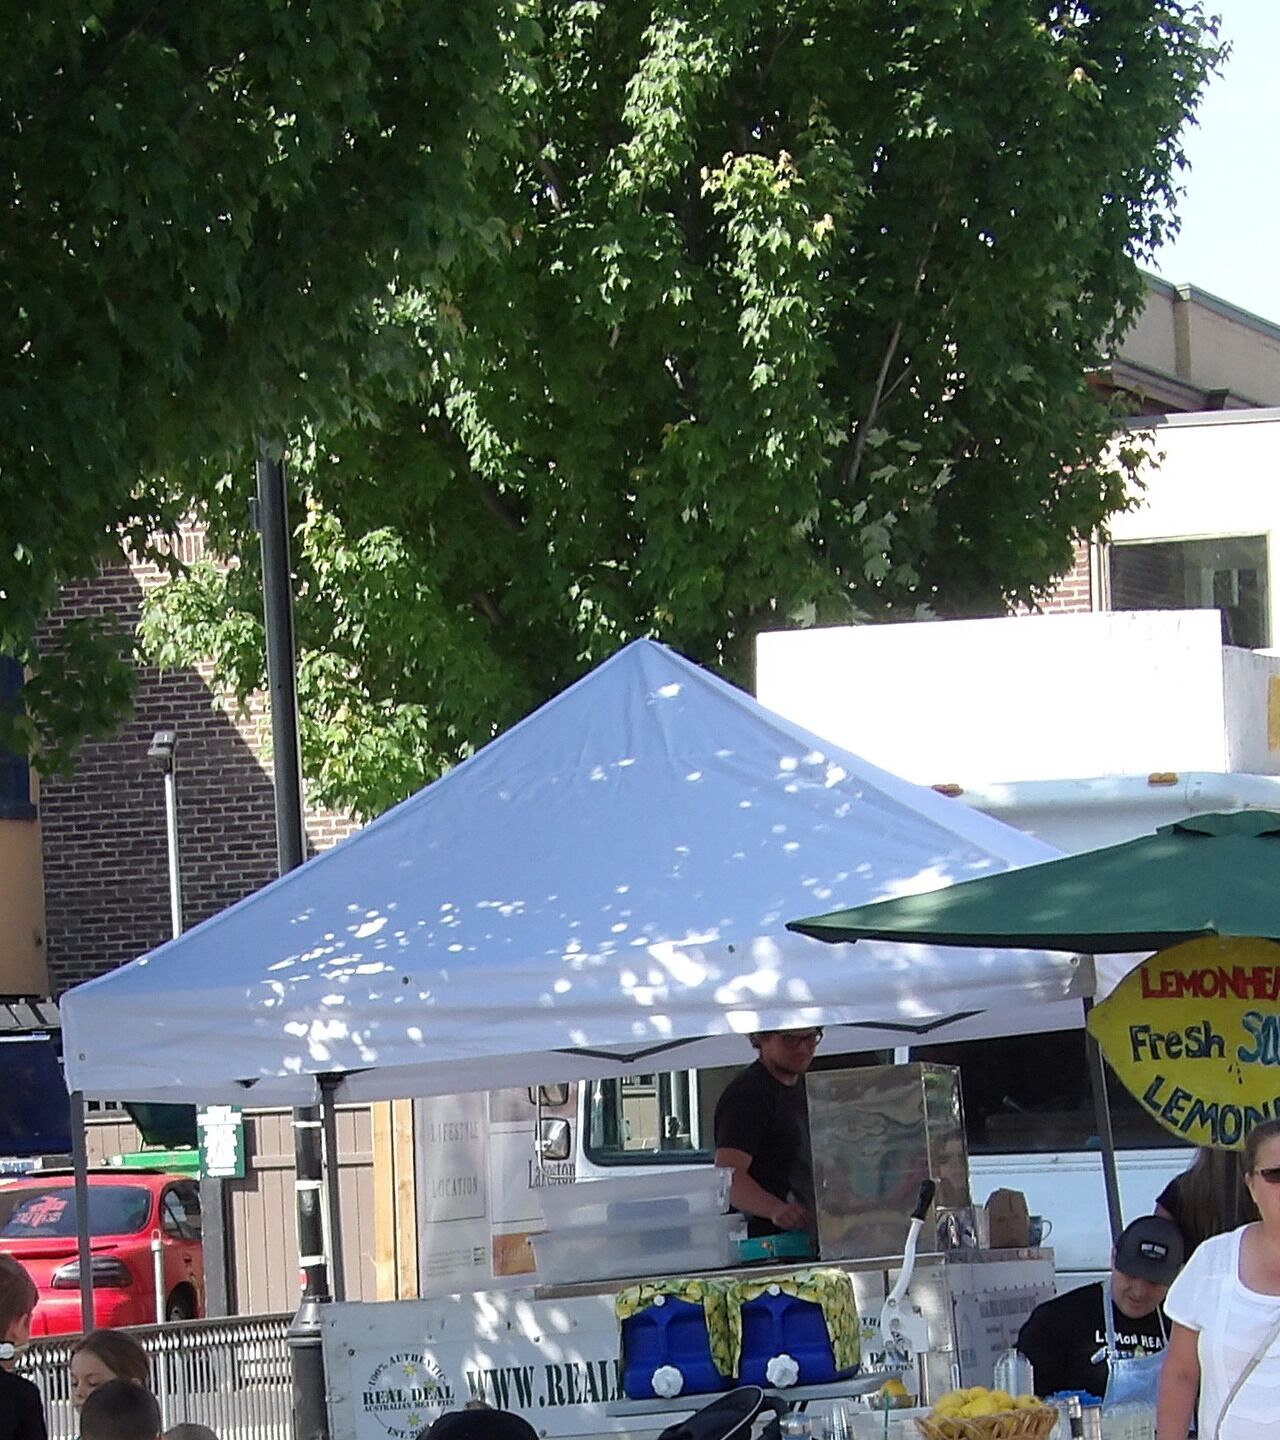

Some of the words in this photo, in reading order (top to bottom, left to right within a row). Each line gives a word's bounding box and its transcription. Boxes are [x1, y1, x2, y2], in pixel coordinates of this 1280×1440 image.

[1129, 1020, 1226, 1062] Fresh
[363, 1388, 407, 1406] REAL
[411, 1385, 456, 1402] DEAL
